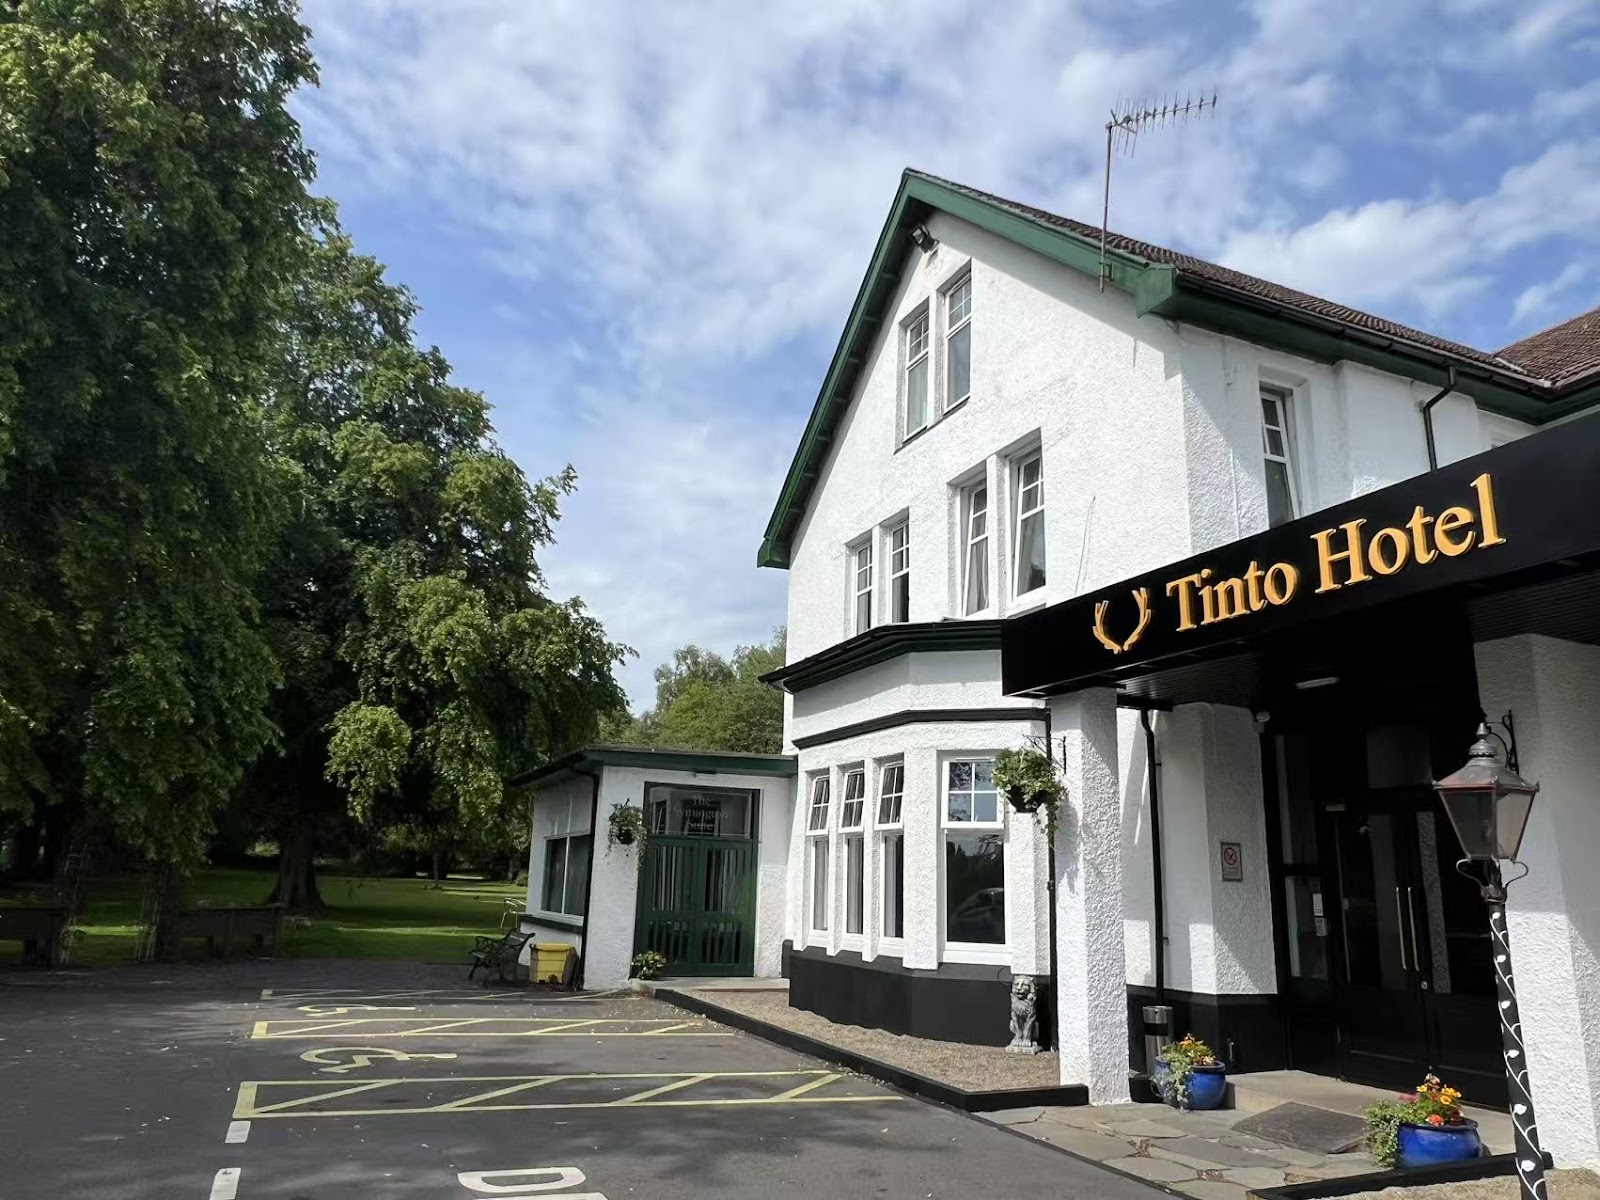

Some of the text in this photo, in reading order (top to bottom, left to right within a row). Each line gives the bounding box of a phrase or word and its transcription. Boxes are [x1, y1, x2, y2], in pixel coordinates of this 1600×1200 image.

[1166, 473, 1506, 632] Tinto Hotel
[692, 794, 712, 805] The
